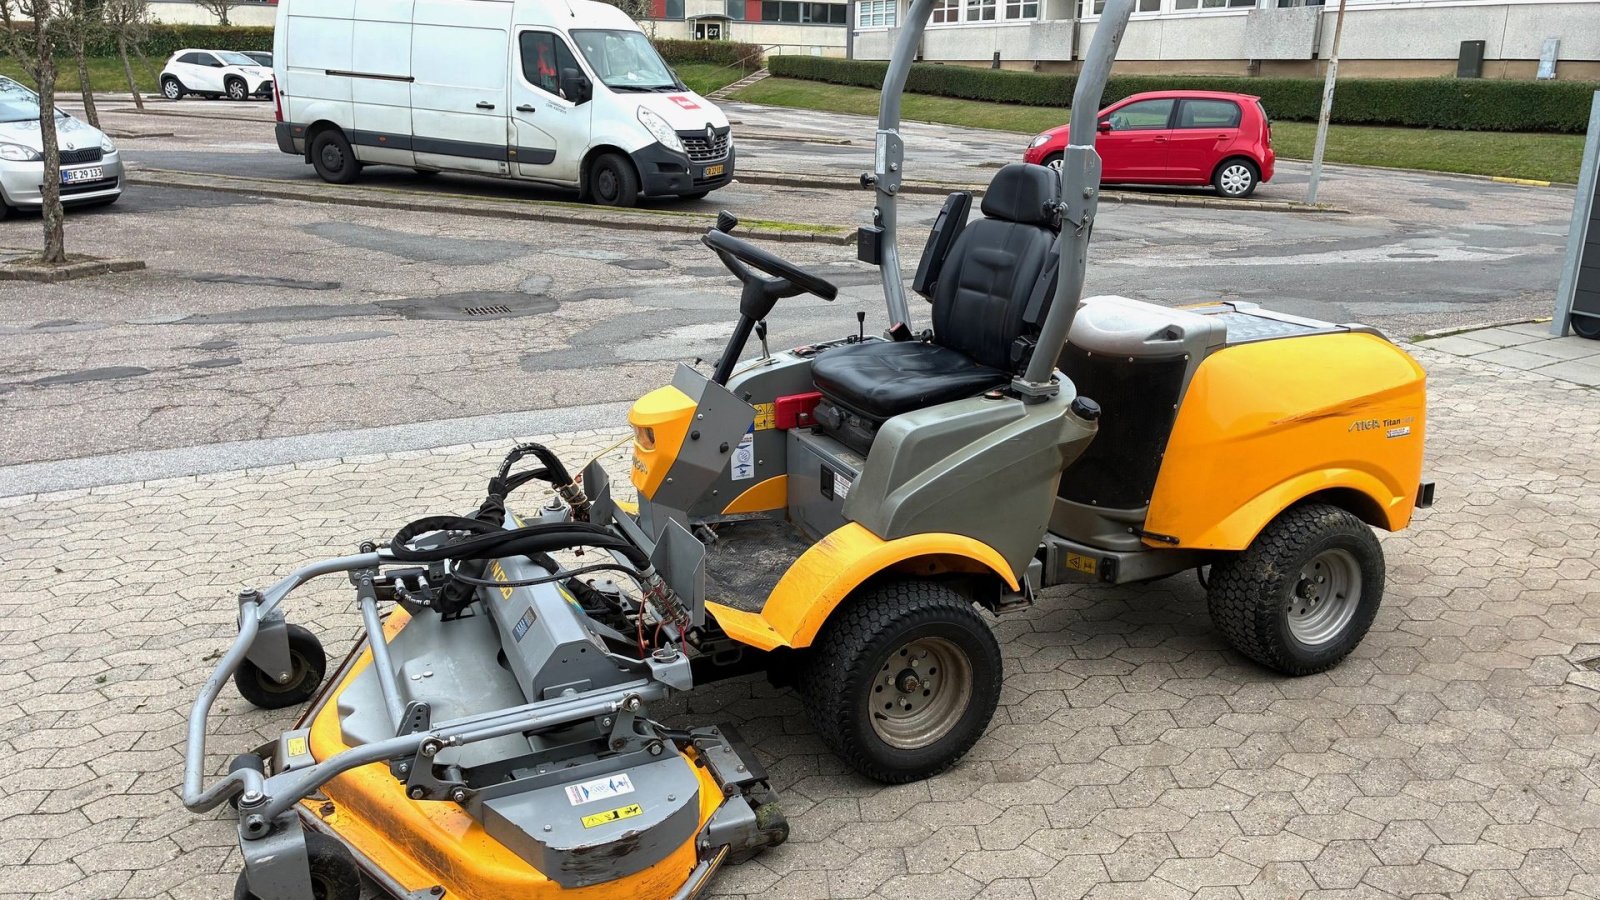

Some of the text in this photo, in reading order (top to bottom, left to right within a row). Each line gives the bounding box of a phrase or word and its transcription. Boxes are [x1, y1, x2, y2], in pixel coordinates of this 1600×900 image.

[708, 28, 718, 36] 27
[68, 169, 102, 179] BE 29 133
[1383, 418, 1401, 427] Titan
